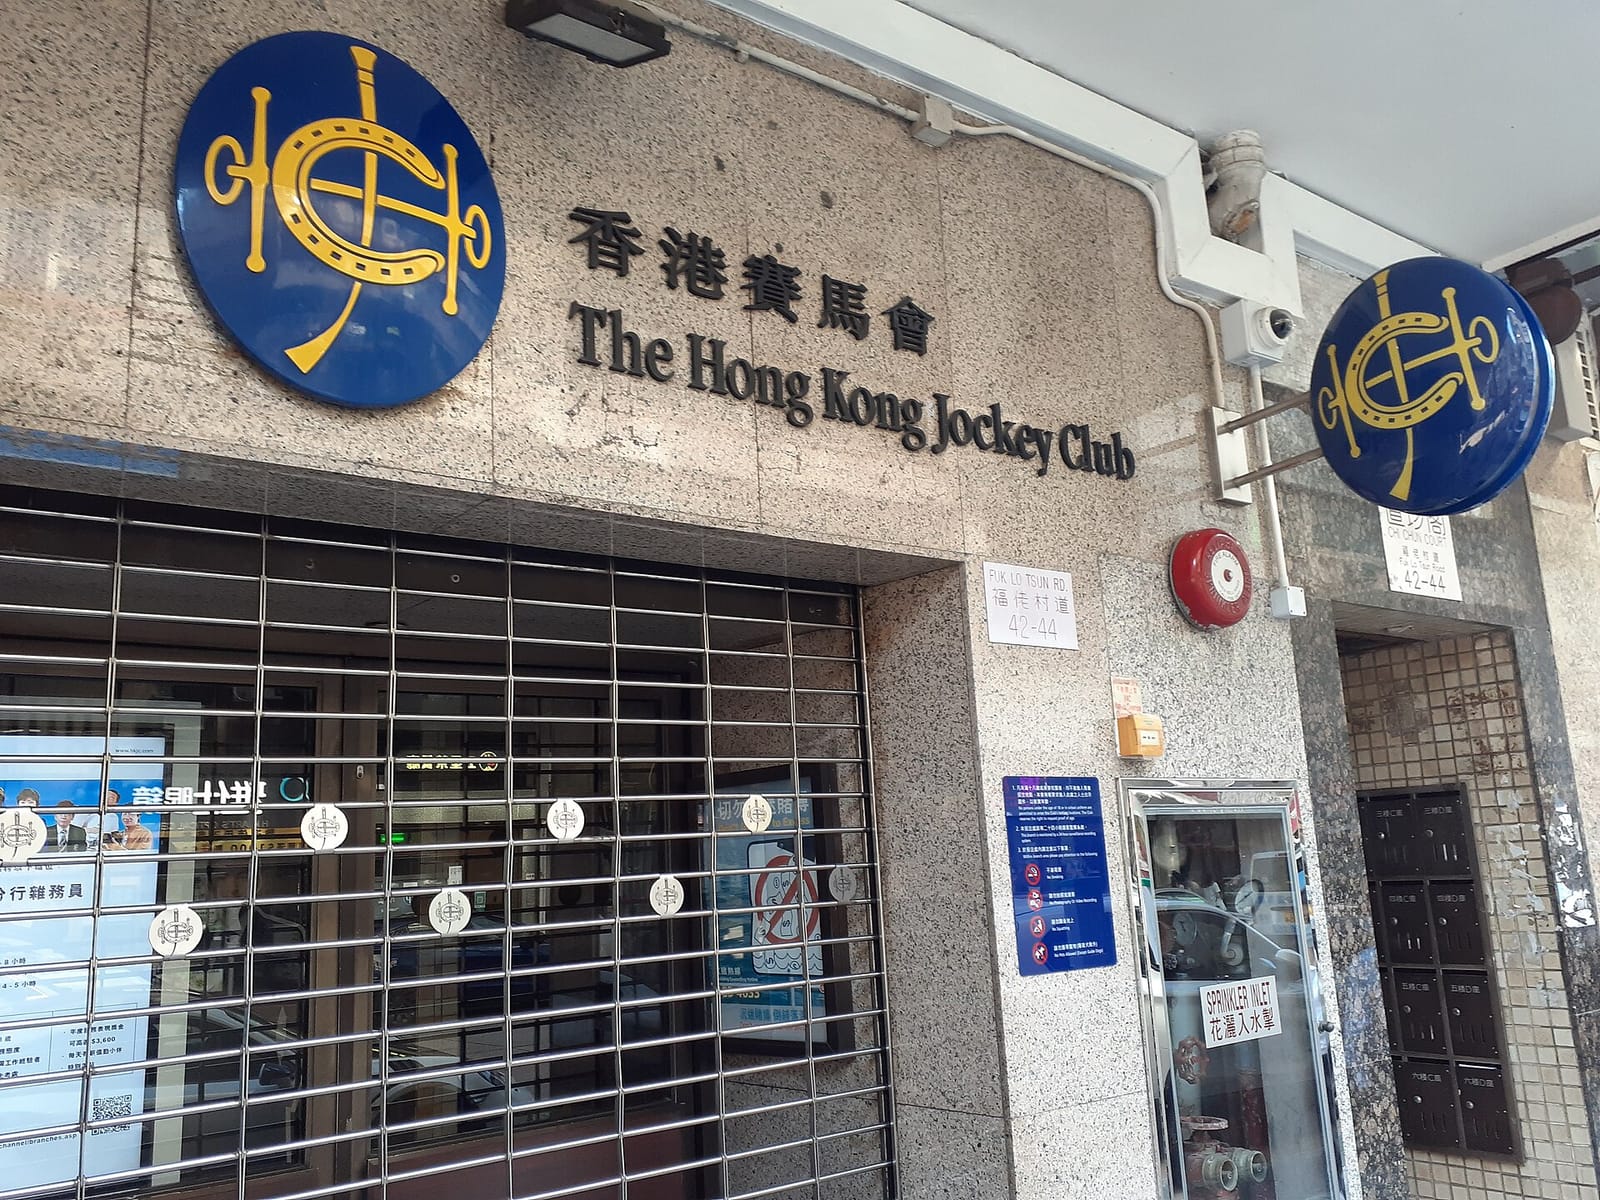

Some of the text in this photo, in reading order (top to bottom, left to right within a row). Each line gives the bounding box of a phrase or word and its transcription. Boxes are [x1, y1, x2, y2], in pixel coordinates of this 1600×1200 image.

[569, 206, 935, 356] 香港賽馬會
[568, 300, 1136, 481] The Hong Kong Jockey Club
[989, 568, 1068, 592] FUK LO TSUN RD.
[1404, 569, 1447, 593] 42-44
[992, 588, 1070, 614] 福佬村道
[1008, 614, 1058, 641] 42-44
[1206, 981, 1271, 1015] SPRINKLER INLET
[91, 1036, 116, 1045] $3,600
